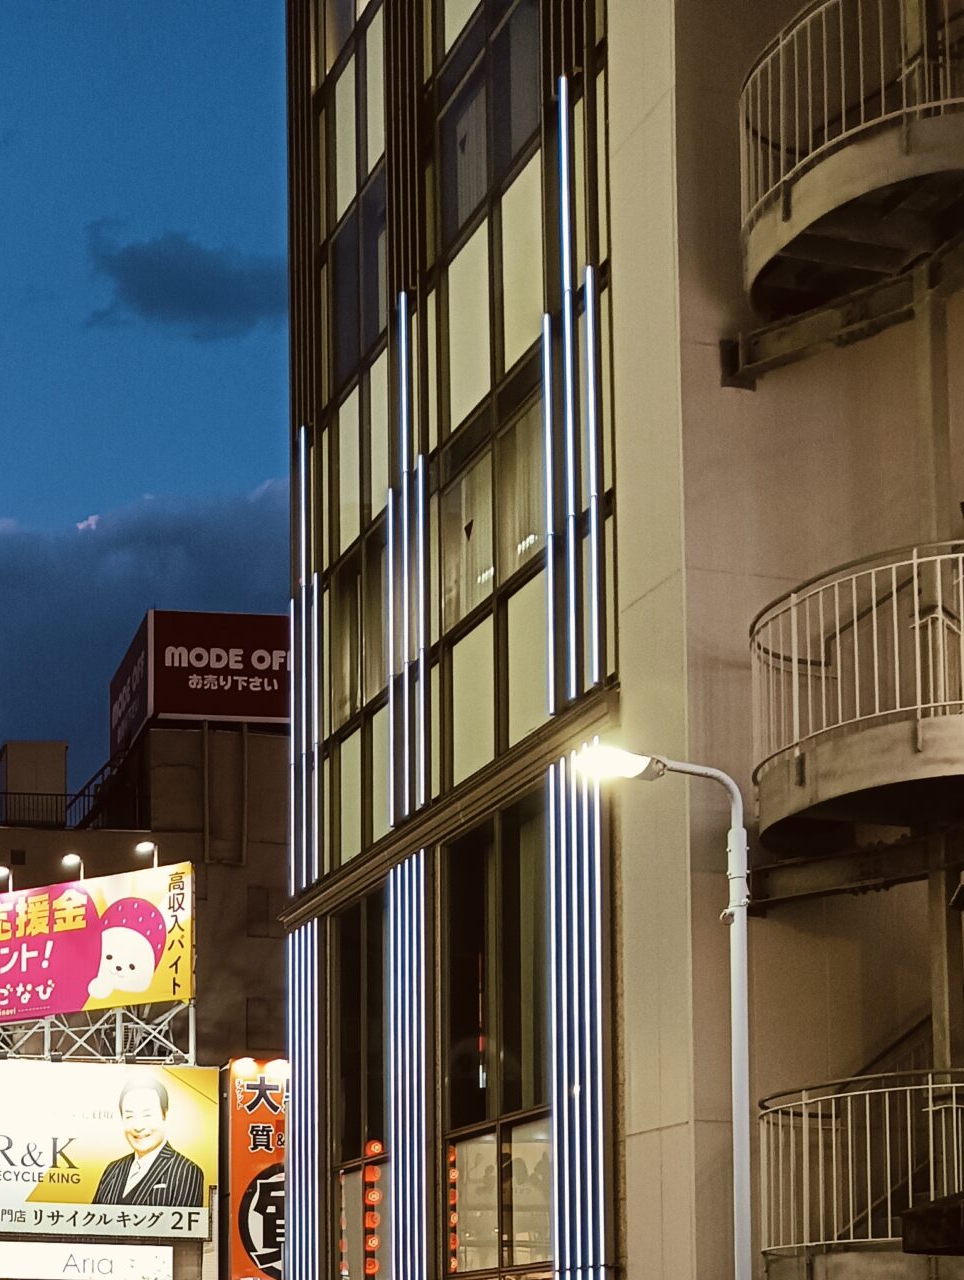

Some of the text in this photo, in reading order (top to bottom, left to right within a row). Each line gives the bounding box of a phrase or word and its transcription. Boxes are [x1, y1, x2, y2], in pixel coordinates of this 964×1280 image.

[164, 646, 291, 671] MODE OF
[188, 674, 278, 691] お売り下さい
[168, 871, 186, 995] 高収入バイト
[49, 1173, 81, 1184] KING
[171, 1211, 201, 1231] 2F
